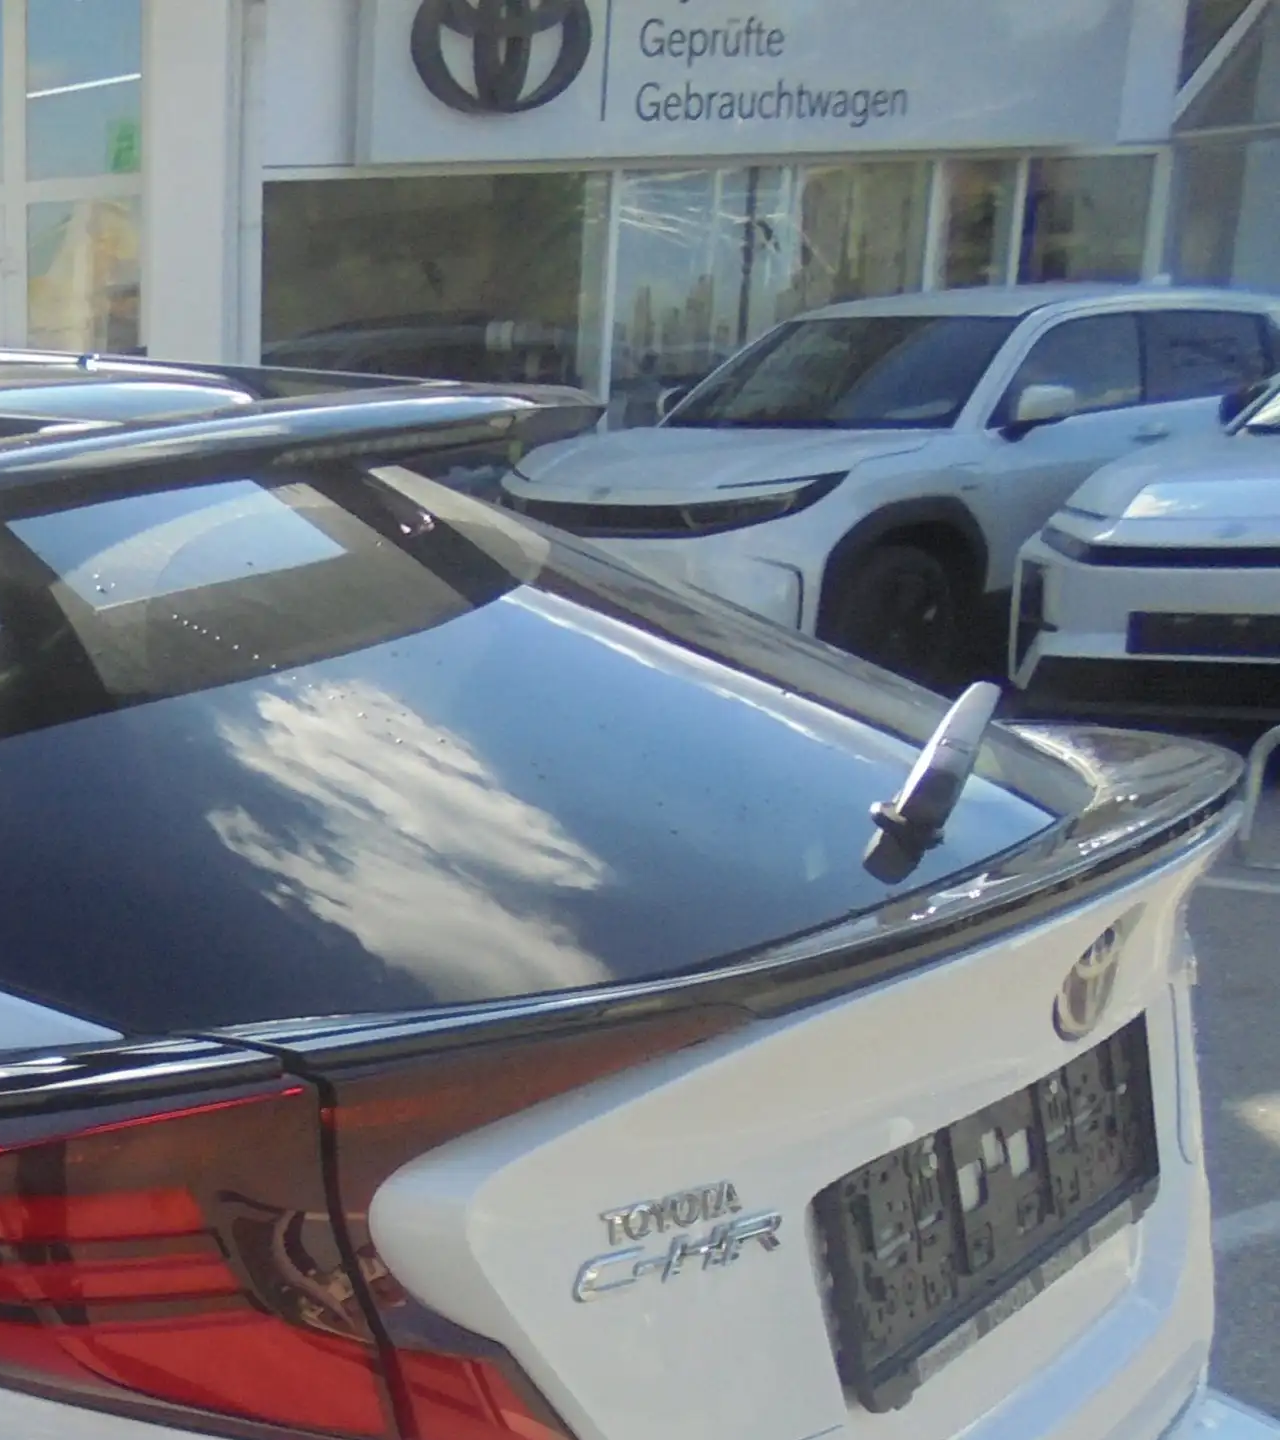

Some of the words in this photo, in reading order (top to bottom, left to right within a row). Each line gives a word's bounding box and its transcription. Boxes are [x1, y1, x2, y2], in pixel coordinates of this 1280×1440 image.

[639, 16, 786, 67] Geprüfte
[635, 78, 909, 128] Gebrauchtwagen
[598, 1179, 743, 1246] TOYOTA
[572, 1207, 783, 1304] C-HR
